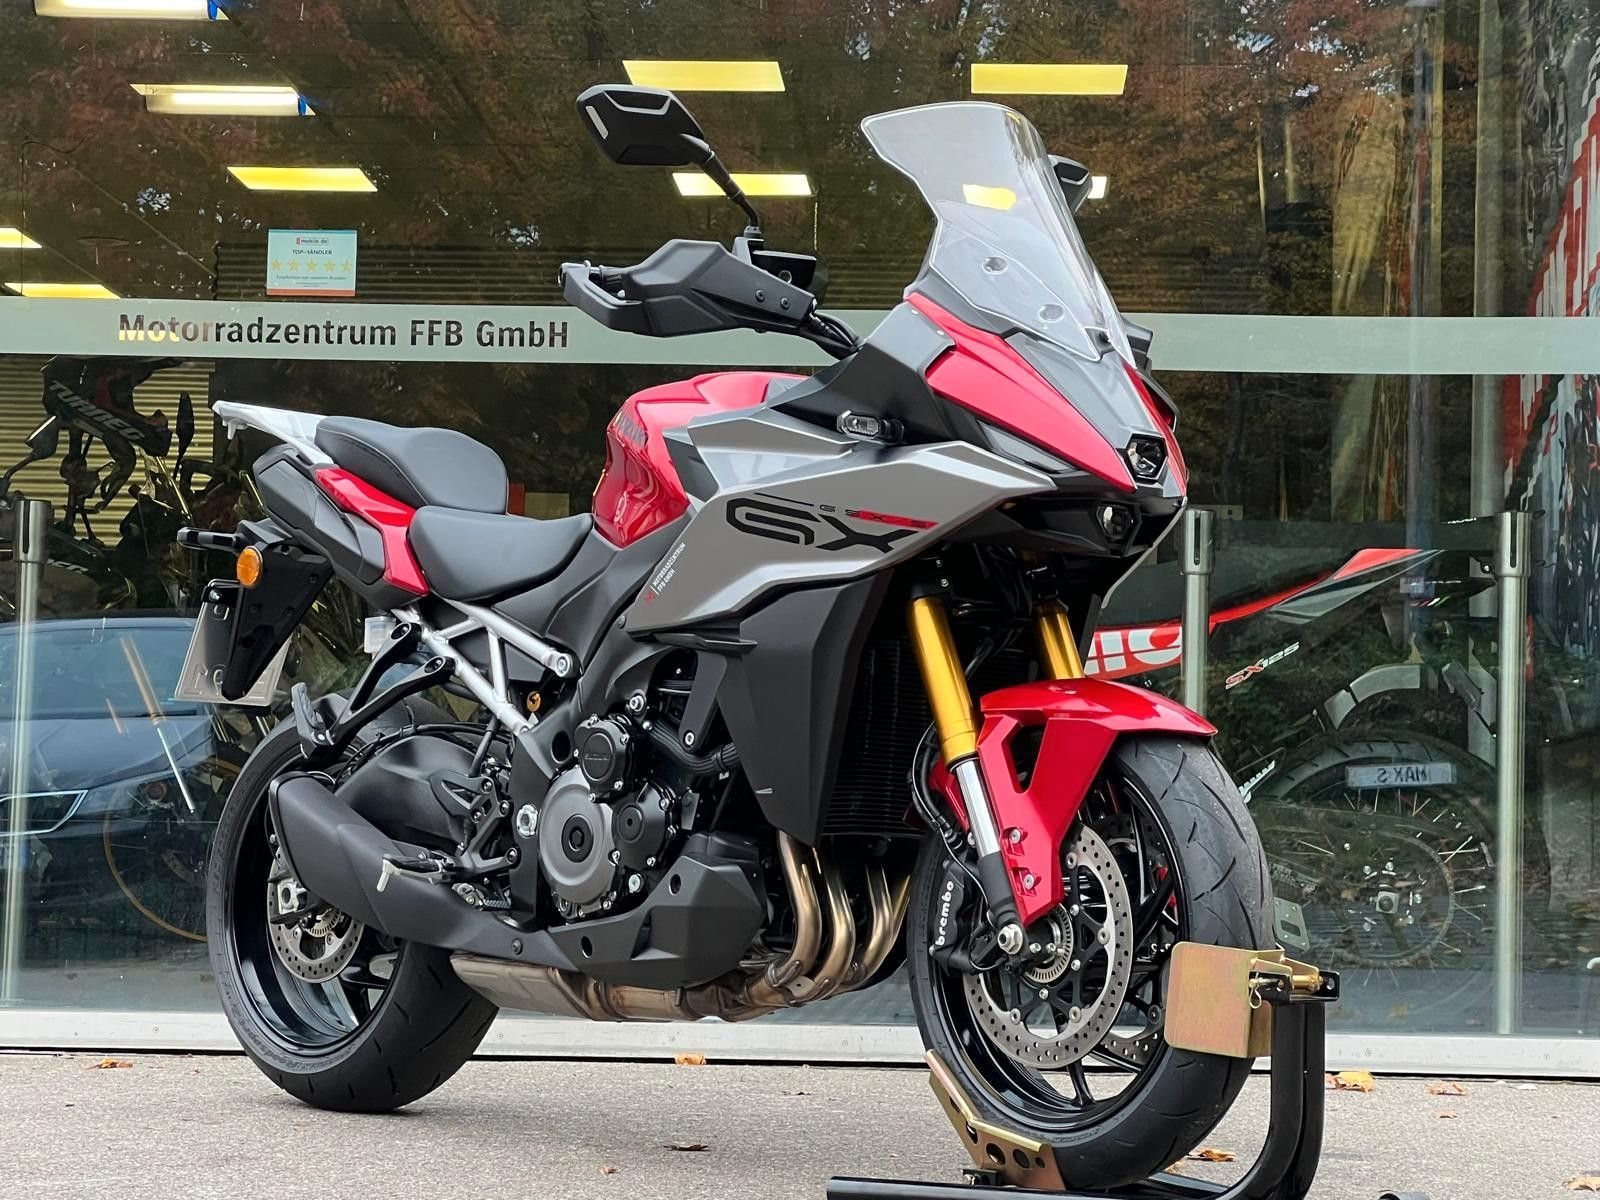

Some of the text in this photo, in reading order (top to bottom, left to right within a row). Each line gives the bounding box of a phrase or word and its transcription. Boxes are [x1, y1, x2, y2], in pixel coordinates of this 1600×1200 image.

[118, 313, 569, 348] Motorradzentrum FFB GmbH
[934, 880, 954, 947] brembo
